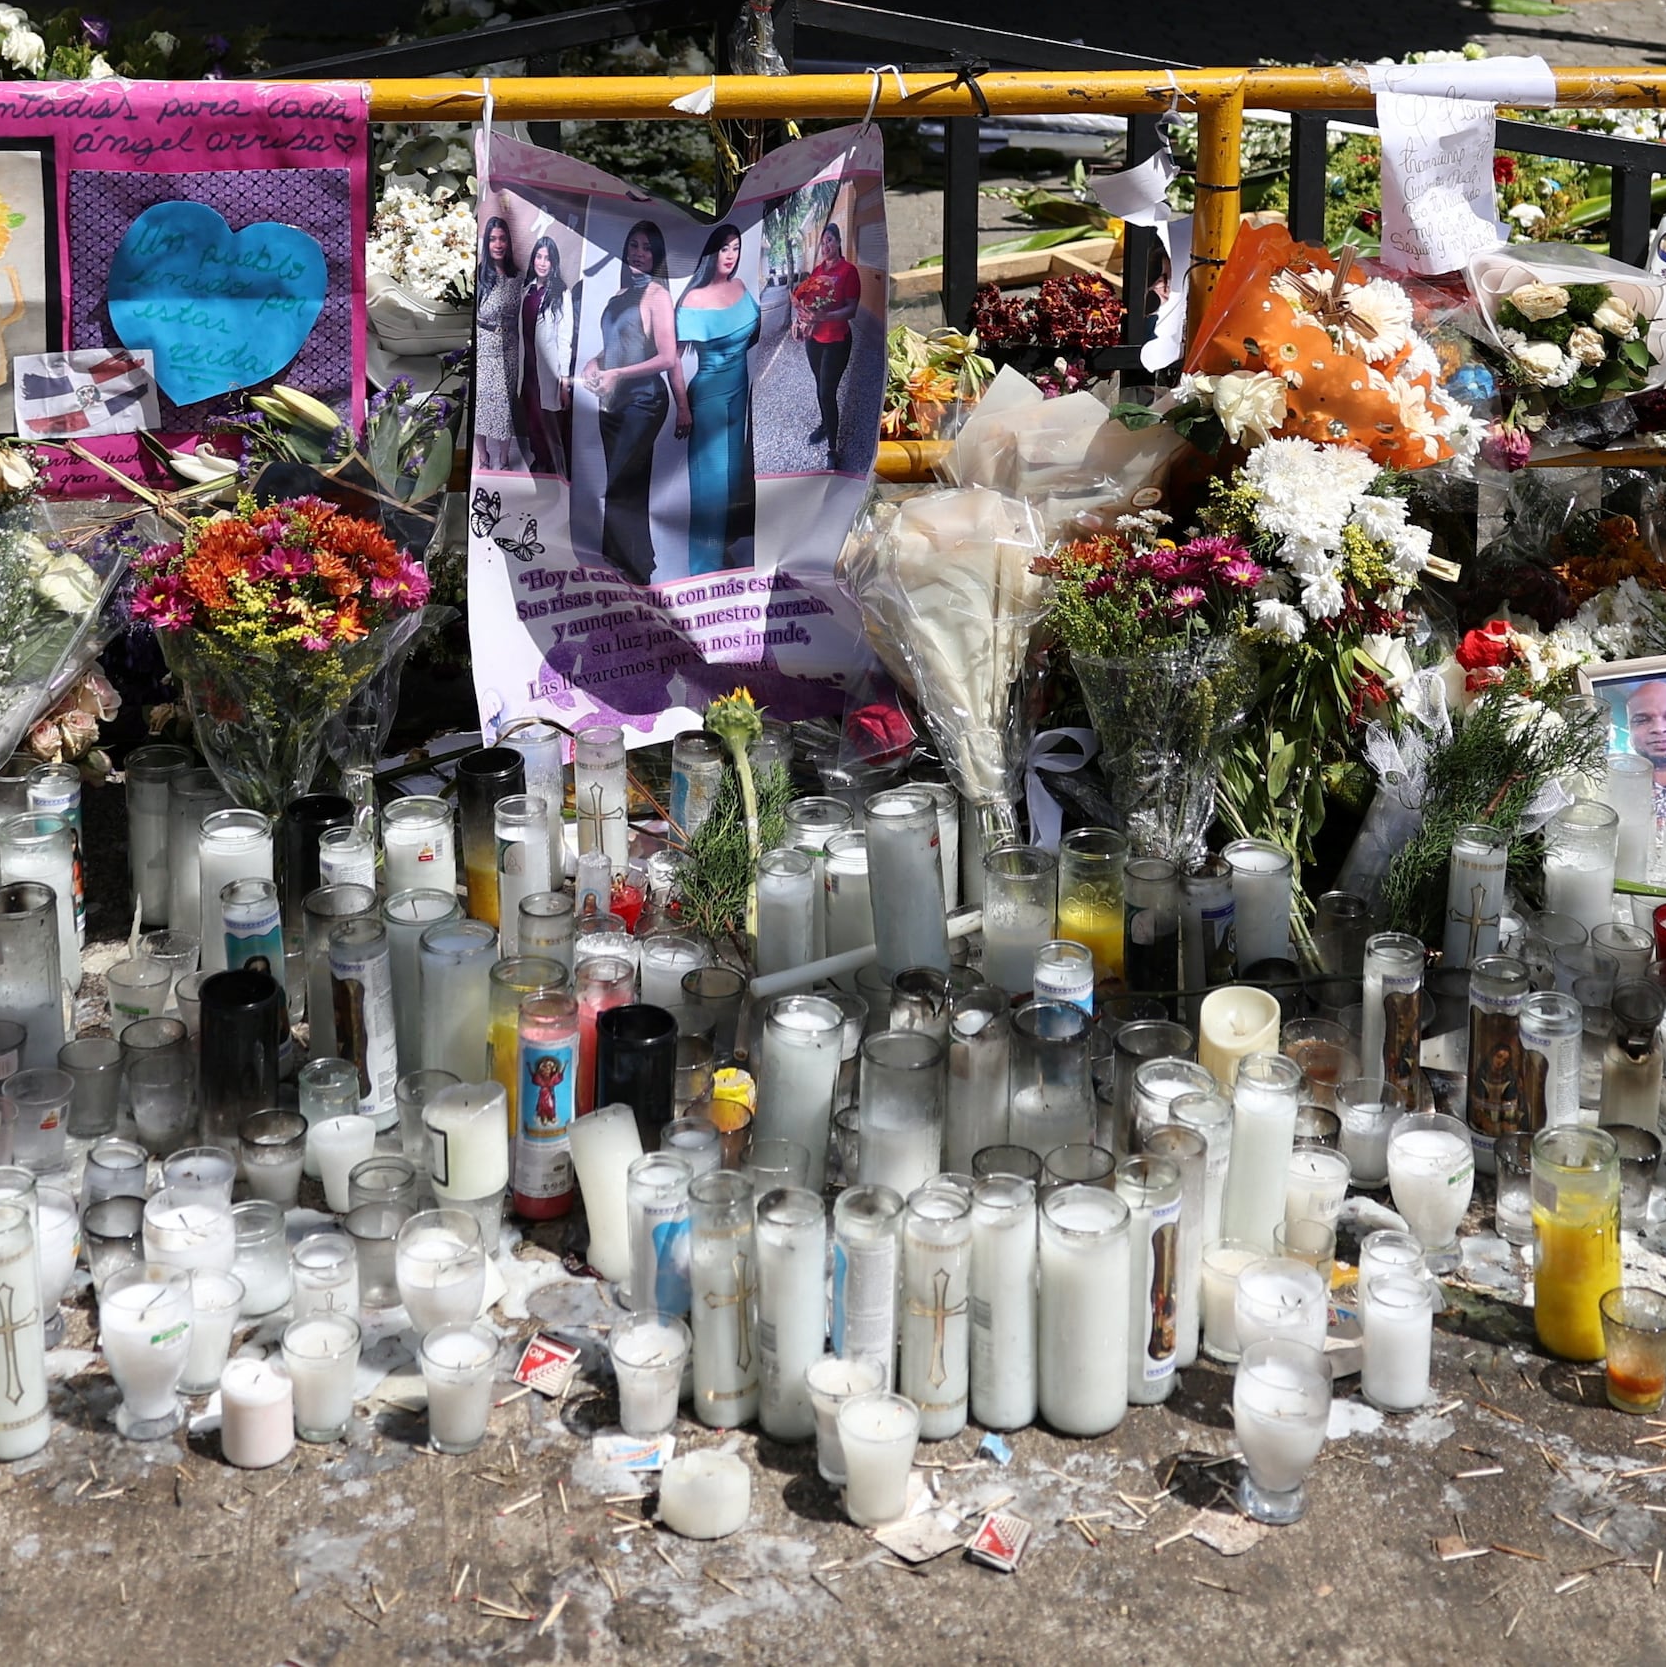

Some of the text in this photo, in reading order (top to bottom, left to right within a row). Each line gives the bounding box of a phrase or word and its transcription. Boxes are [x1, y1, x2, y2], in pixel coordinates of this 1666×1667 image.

[156, 96, 250, 125] para
[266, 94, 357, 125] cada
[72, 125, 332, 165] ángel arriba
[132, 224, 307, 281] Un pueblo
[133, 301, 232, 334] estas
[256, 291, 309, 319] por
[677, 589, 707, 606] con
[711, 577, 745, 598] más
[517, 602, 547, 620] Sus
[549, 592, 593, 612] risas
[697, 606, 761, 627] nuestro
[553, 623, 566, 644] y
[569, 610, 635, 636] aunque
[637, 606, 655, 622] la
[712, 635, 742, 650] nos
[746, 621, 812, 646] inunde,
[592, 643, 611, 657] su
[616, 633, 643, 652] luz
[528, 681, 558, 700] Las
[562, 659, 656, 690] llevaremos
[660, 651, 690, 674] por
